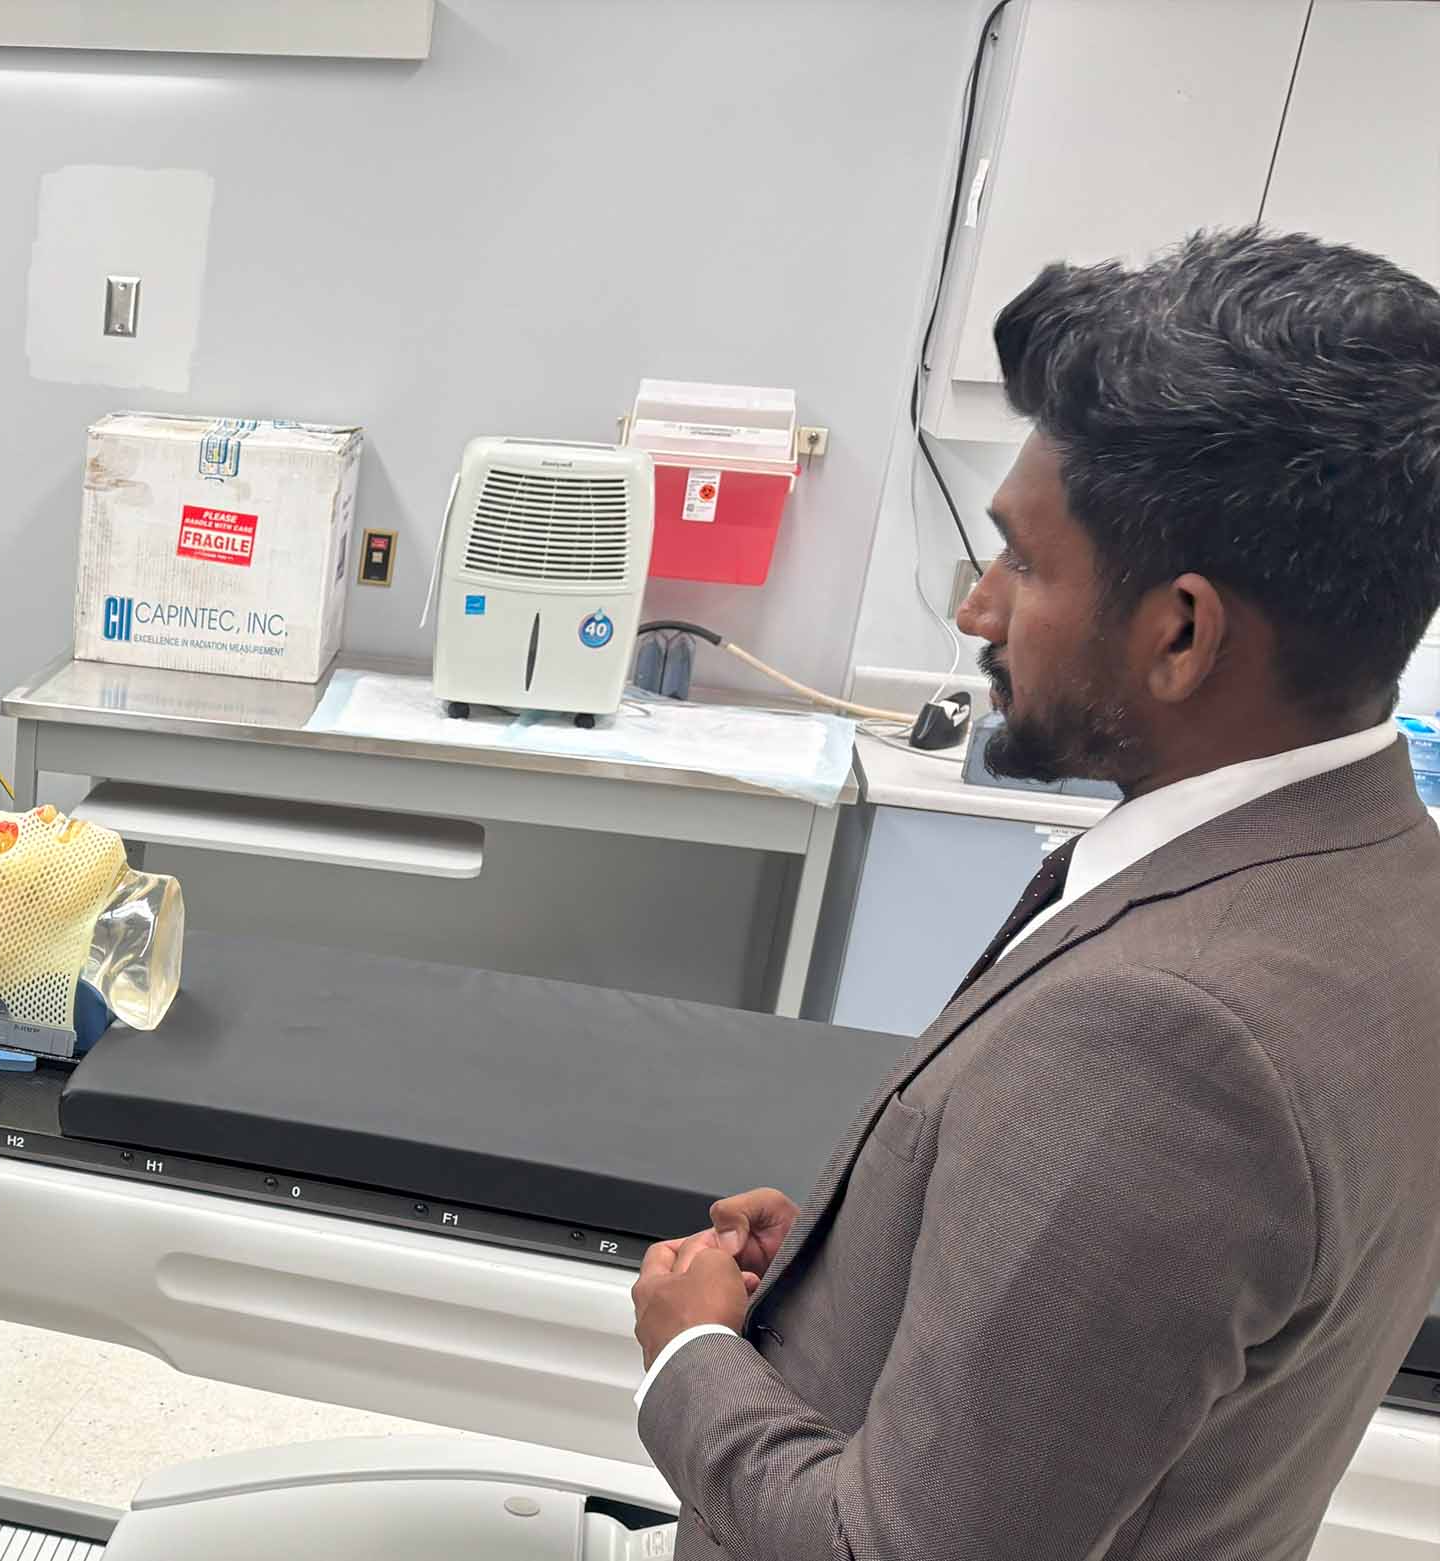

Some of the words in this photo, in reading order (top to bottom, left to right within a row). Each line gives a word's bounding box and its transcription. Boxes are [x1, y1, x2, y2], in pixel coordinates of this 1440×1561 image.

[202, 511, 238, 524] PLEASE
[214, 522, 232, 530] WITH
[233, 525, 254, 534] CARE
[182, 530, 250, 554] FRAGILE
[135, 601, 241, 634] CAPINTEC,
[247, 612, 289, 638] INC.
[585, 622, 607, 637] 40
[133, 633, 180, 648] EXCELLENCE
[181, 638, 189, 648] IN
[190, 640, 228, 652] RADIATION
[229, 643, 285, 657] MEASUREMENT
[7, 1134, 25, 1148] H2
[146, 1159, 164, 1173] H1
[291, 1186, 301, 1198] 0
[442, 1212, 459, 1226] F1
[599, 1240, 619, 1254] F2
